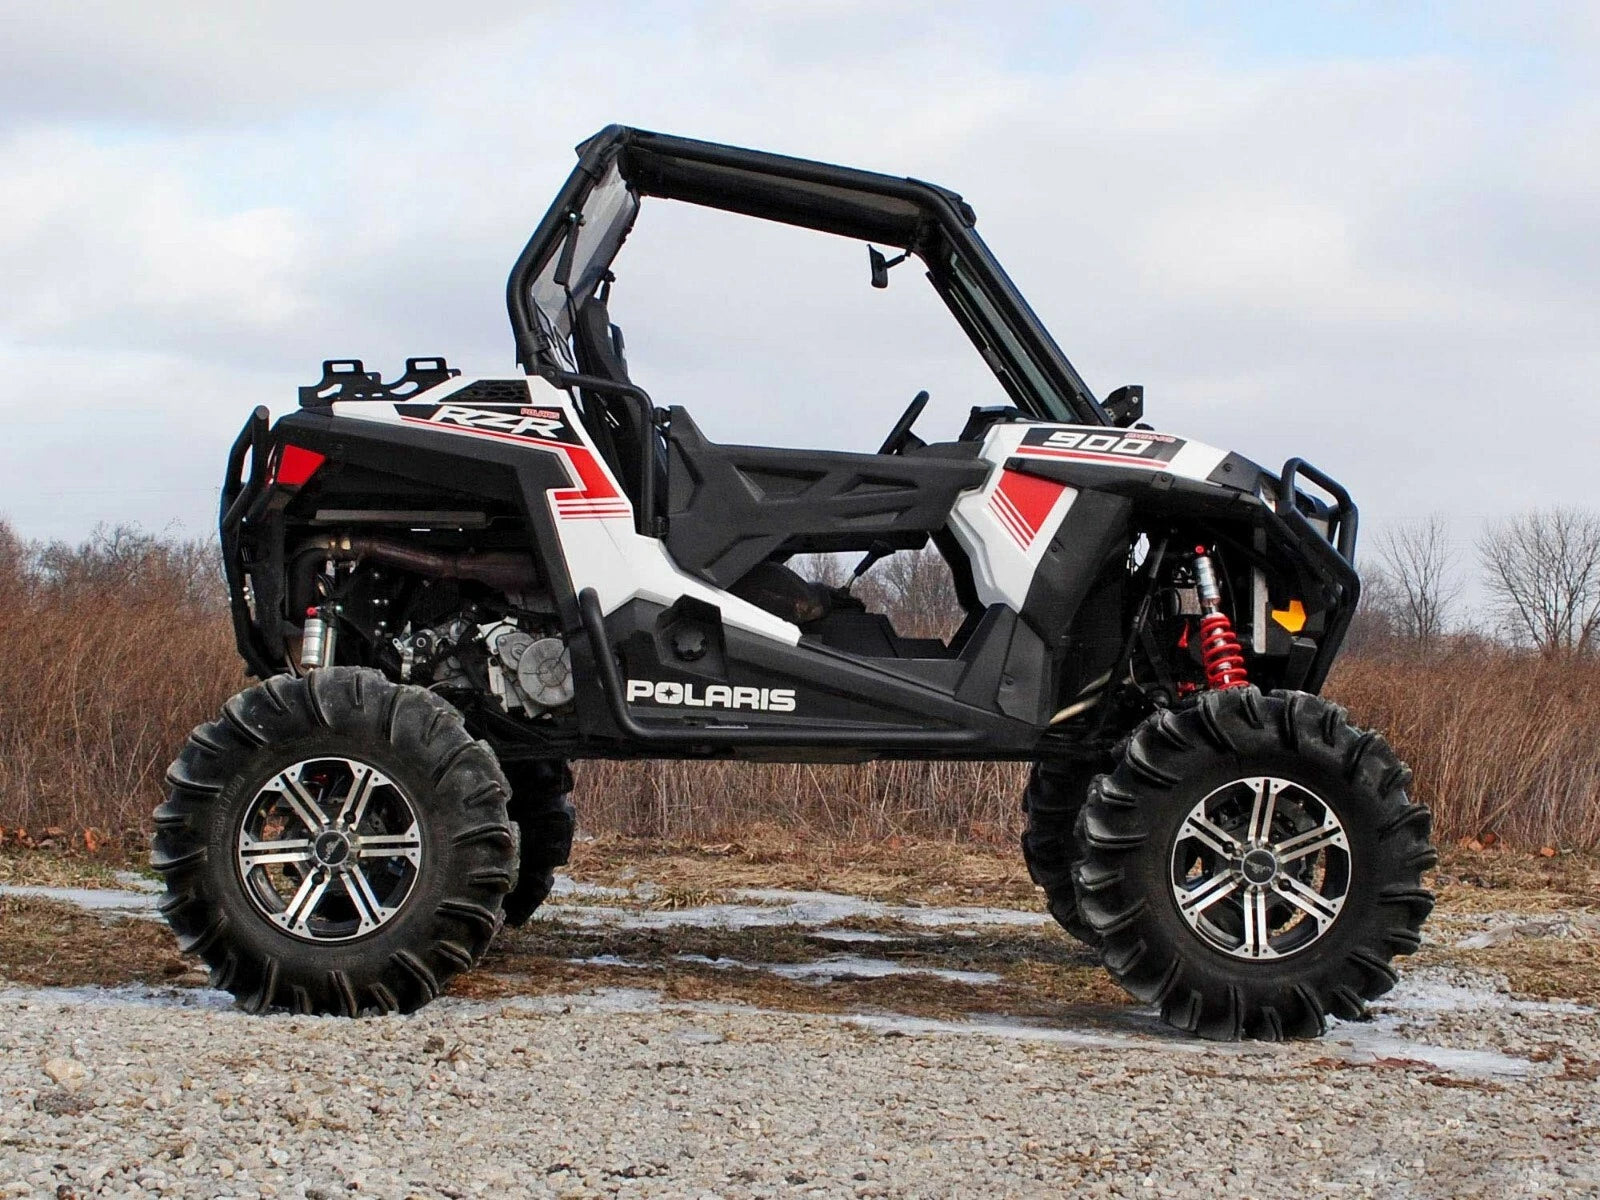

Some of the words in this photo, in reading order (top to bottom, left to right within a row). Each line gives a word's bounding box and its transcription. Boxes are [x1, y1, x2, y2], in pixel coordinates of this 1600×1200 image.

[430, 405, 564, 438] RZR
[520, 407, 560, 419] POLARIS
[1042, 431, 1153, 455] 900
[626, 679, 796, 712] POLARIS
